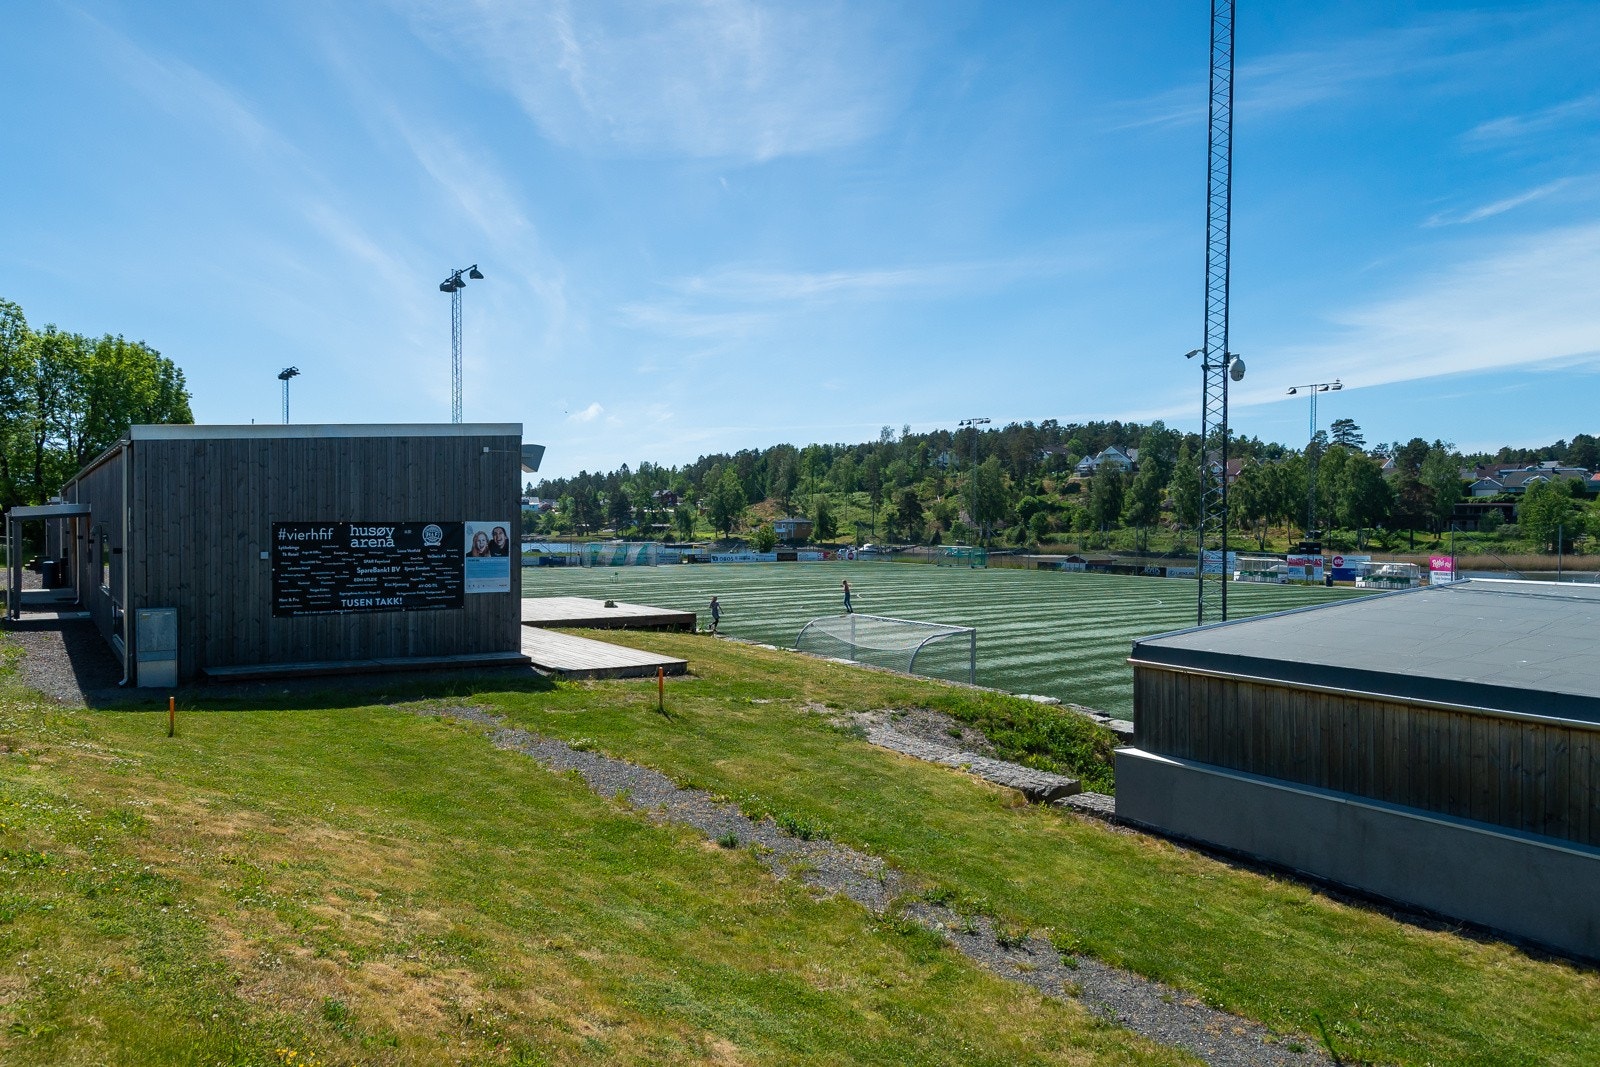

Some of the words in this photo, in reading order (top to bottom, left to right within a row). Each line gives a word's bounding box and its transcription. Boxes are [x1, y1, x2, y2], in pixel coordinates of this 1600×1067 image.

[278, 528, 334, 541] #vierhfif
[349, 524, 396, 539] husøy
[350, 538, 396, 548] arena
[341, 598, 373, 607] TUSEN
[375, 597, 403, 606] TAKK!
